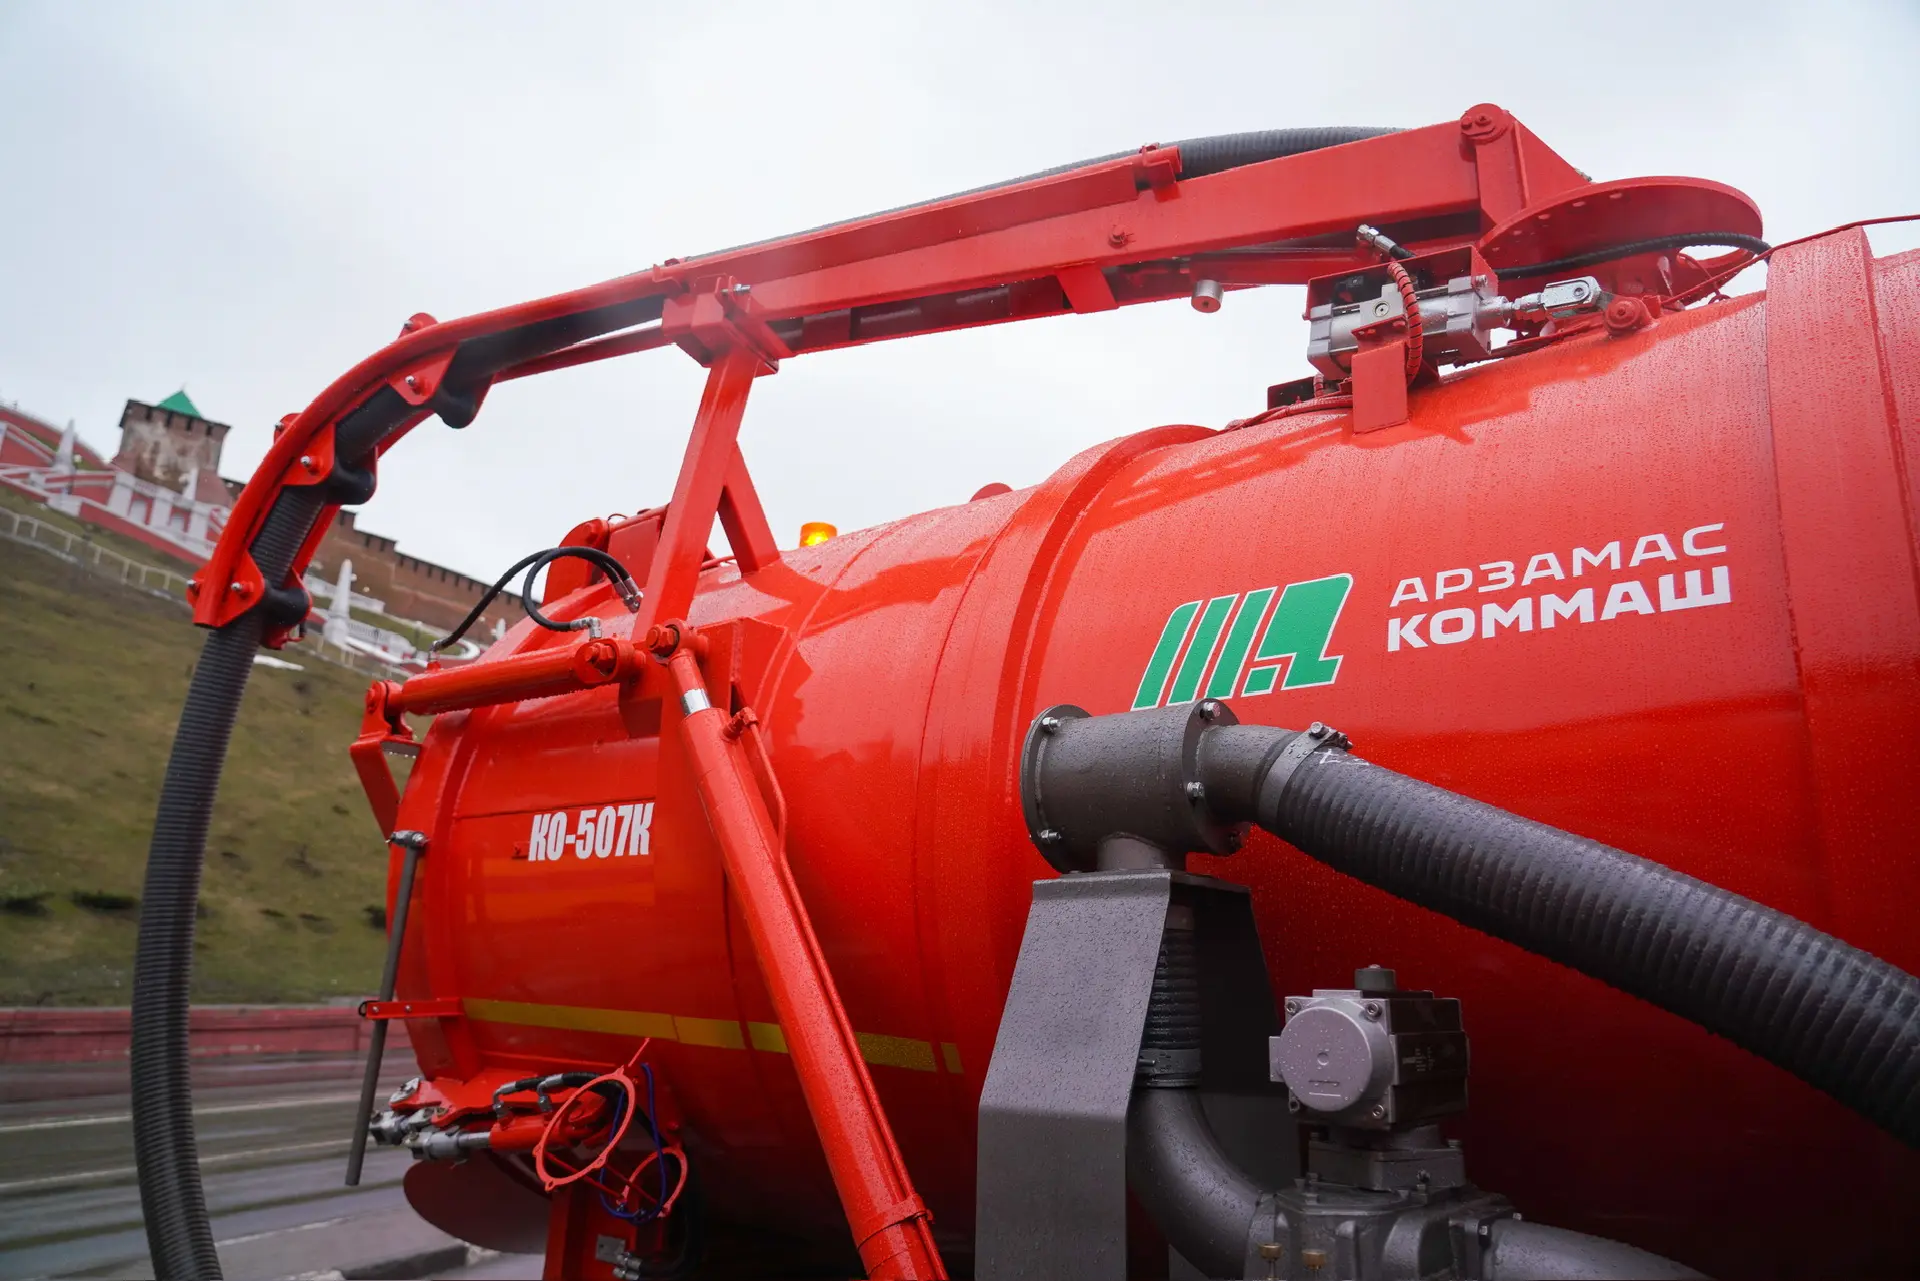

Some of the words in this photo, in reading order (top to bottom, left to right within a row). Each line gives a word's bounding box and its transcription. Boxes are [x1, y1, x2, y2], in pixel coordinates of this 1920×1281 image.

[1389, 522, 1727, 607] АРЗАМАС
[1387, 565, 1731, 652] КОММАШ
[528, 802, 655, 861] КО-507К
